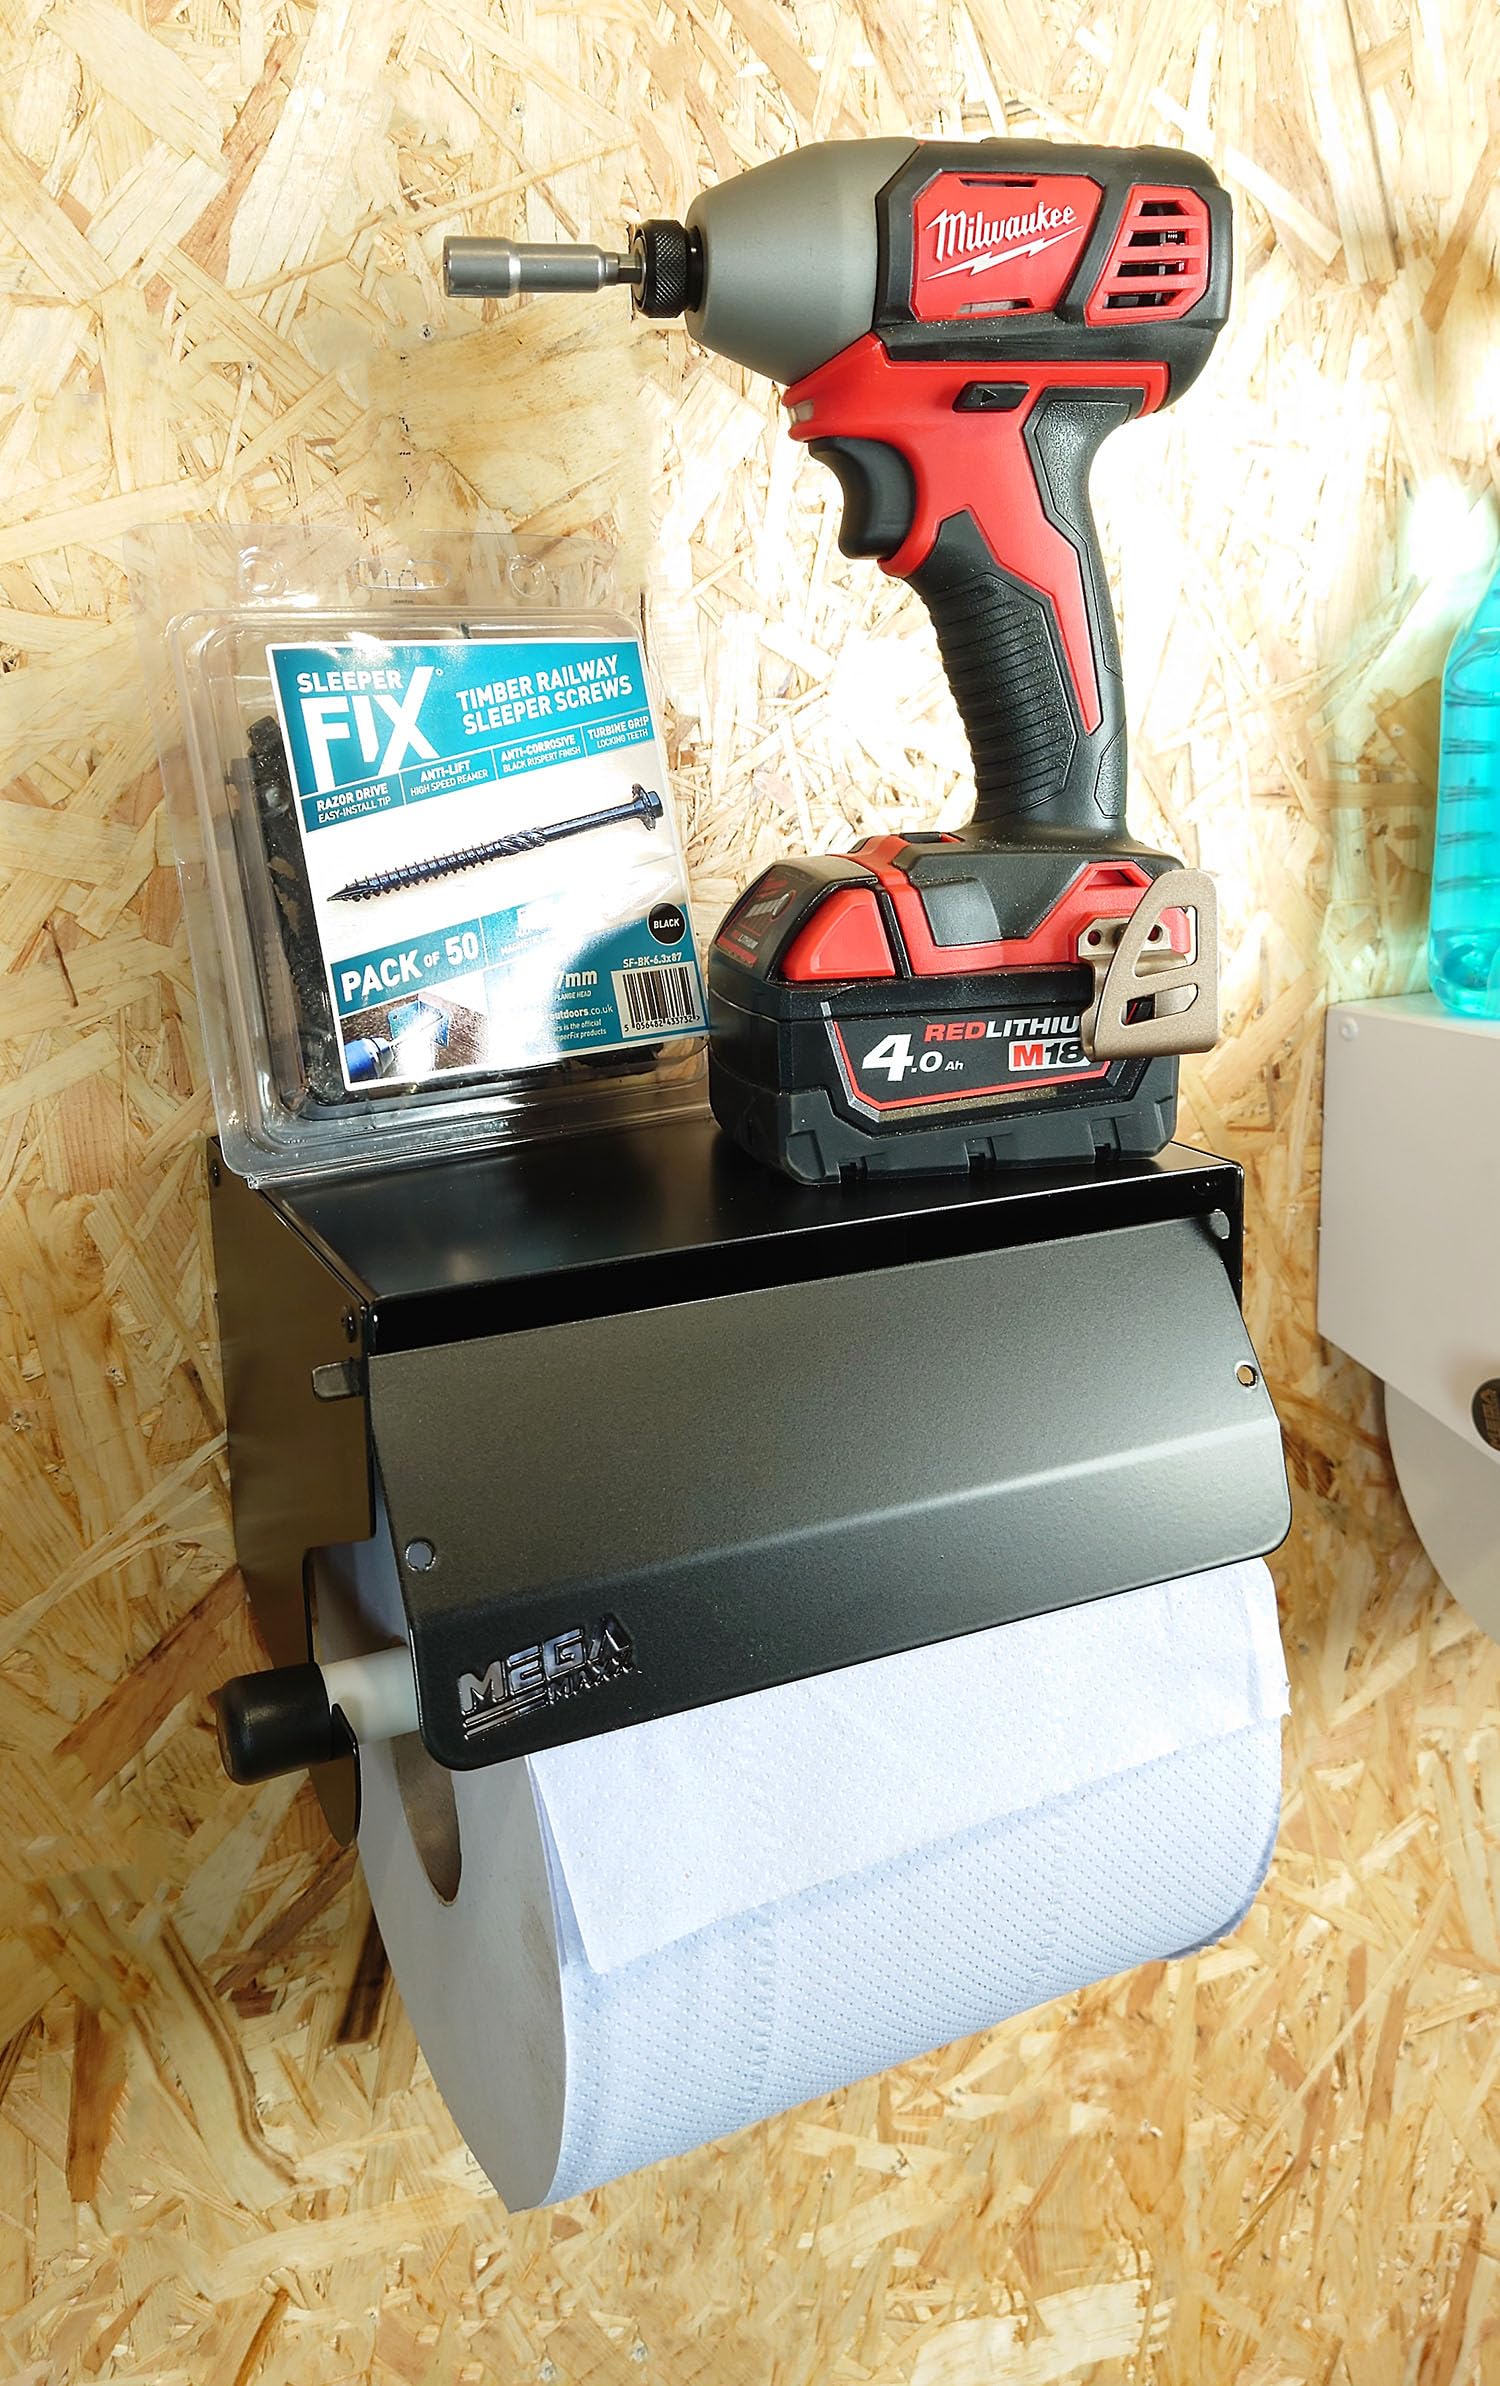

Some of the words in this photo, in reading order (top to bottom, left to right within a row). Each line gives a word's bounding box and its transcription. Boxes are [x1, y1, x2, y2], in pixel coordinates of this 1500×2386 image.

[925, 201, 1077, 263] Milwaukee
[296, 670, 404, 693] SLEEPER
[456, 676, 534, 712] TIMBER
[535, 654, 618, 692] RAILWAY
[462, 695, 553, 735] SLEEPER
[553, 675, 633, 711] SCREWS
[300, 666, 440, 792] FIX
[587, 722, 627, 740] TURBINE
[627, 715, 649, 730] GRIP
[597, 735, 626, 748] LOCKING
[627, 728, 649, 740] TEETH
[501, 734, 576, 762] ANTI-CORROSIVE
[502, 759, 527, 773] BLACK
[527, 751, 558, 767] RUSPERT
[558, 746, 582, 758] FINISH
[410, 784, 431, 796] HIGH
[431, 778, 456, 792] SPEED
[457, 769, 489, 784] REAMER
[420, 760, 471, 782] ANTI-LIFT
[316, 791, 355, 812] RAZOR
[355, 782, 389, 802] DRIVE
[318, 801, 378, 824] EASY-INSTALL
[379, 796, 391, 808] TIP
[653, 918, 680, 929] BLACK
[340, 949, 423, 1002] PACK
[423, 951, 440, 968] OF
[444, 931, 479, 966] 50
[623, 952, 682, 968] SF-BK-6.3x87
[924, 1016, 1080, 1043] REDLITHIU
[862, 1034, 943, 1082] 4.0
[944, 1060, 964, 1072] Ah
[1013, 1040, 1084, 1068] M18
[457, 1613, 633, 1717] MEGA
